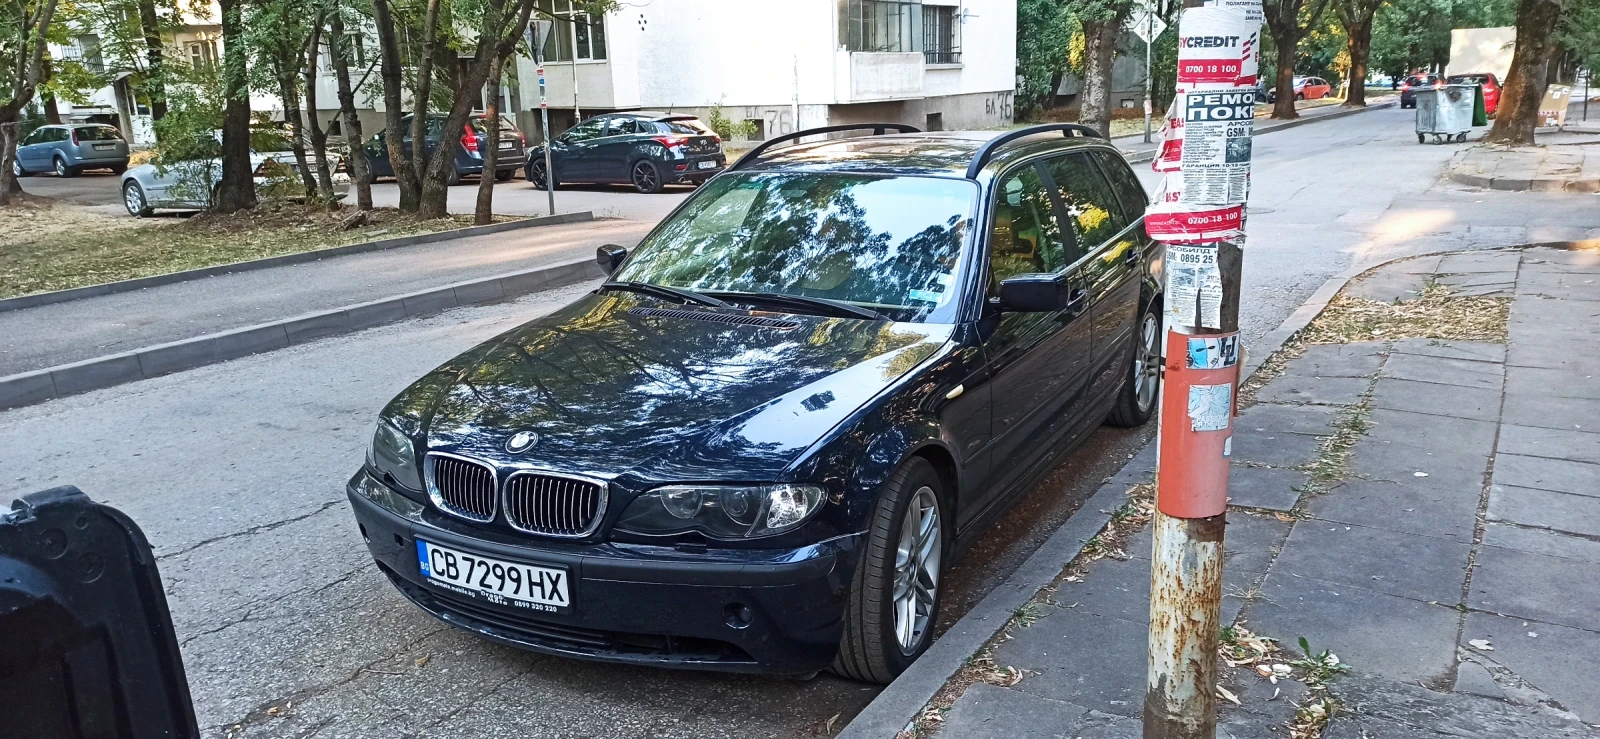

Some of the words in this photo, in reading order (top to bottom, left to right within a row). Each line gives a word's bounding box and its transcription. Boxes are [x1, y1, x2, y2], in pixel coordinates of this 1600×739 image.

[1185, 65, 1204, 74] 0700
[1207, 65, 1218, 73] 18
[1221, 65, 1237, 73] 100
[997, 91, 1012, 119] 76
[765, 110, 792, 135] 76
[1187, 217, 1209, 225] 0700
[1225, 212, 1238, 220] 100
[1180, 253, 1200, 264] 0895
[1202, 254, 1214, 264] 25
[420, 561, 430, 571] BG
[461, 556, 522, 595] 7299
[514, 600, 530, 609] 0899
[531, 603, 544, 611] 320
[544, 605, 558, 613] 220
